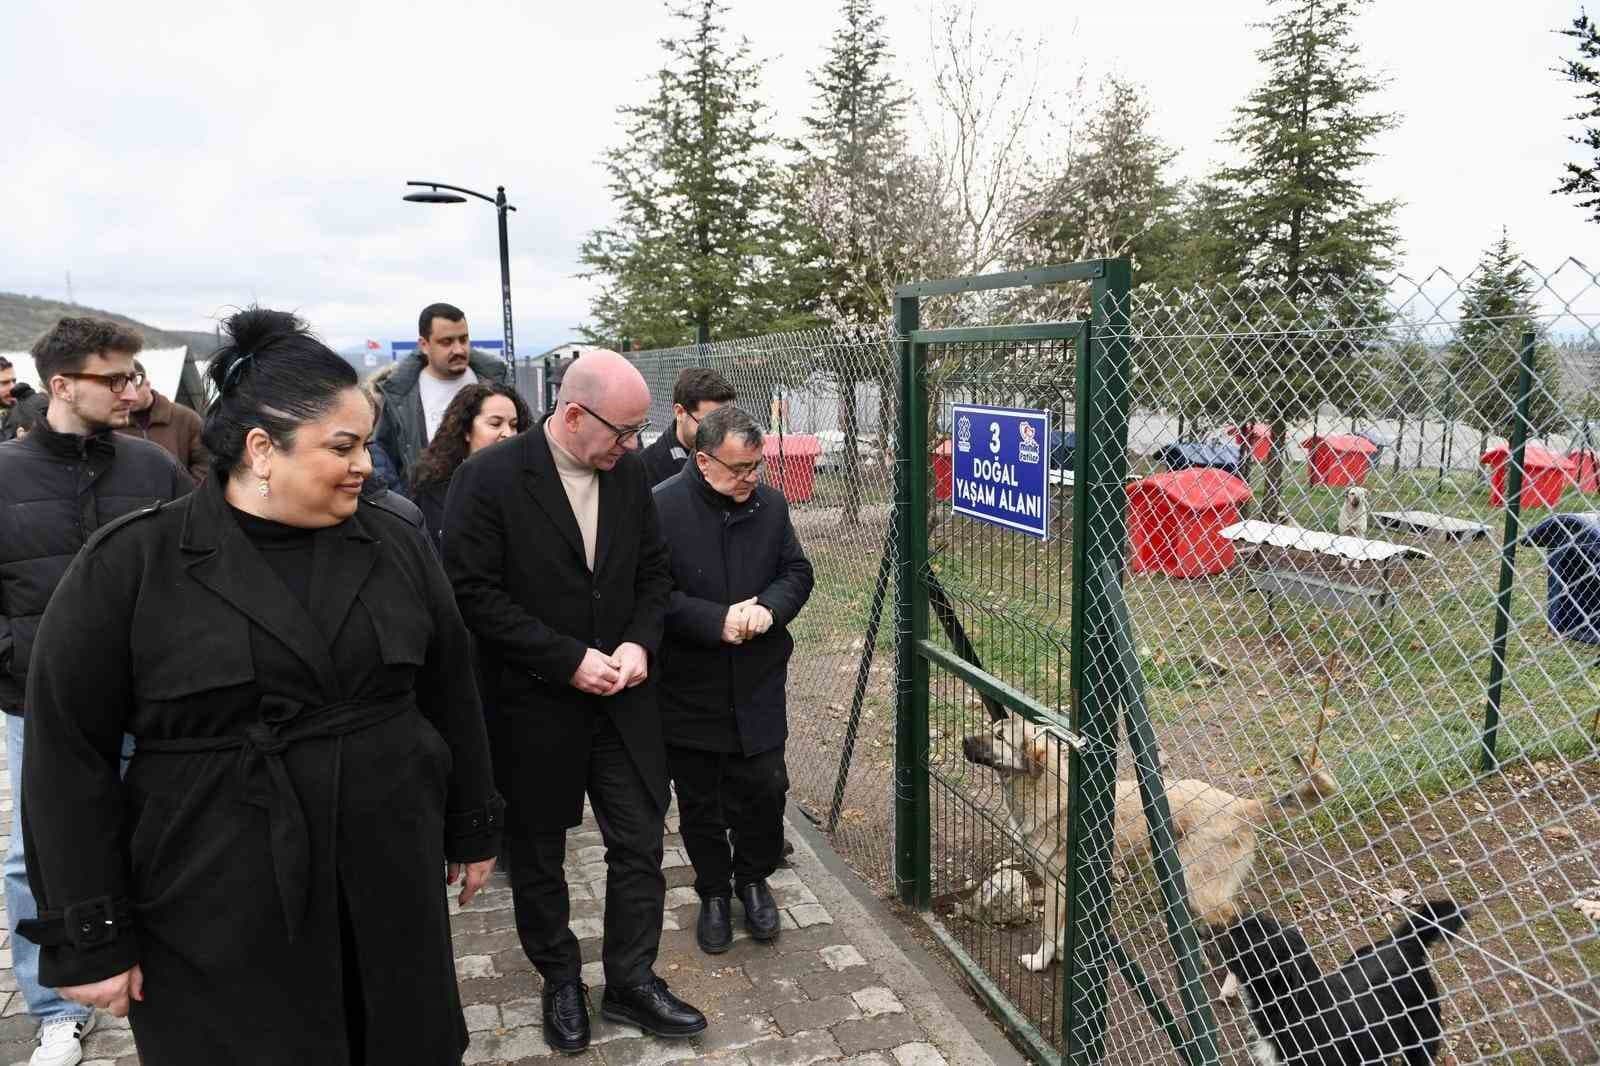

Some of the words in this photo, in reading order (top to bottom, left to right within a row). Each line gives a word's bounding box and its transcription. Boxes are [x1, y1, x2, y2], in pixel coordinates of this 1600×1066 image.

[989, 422, 1000, 451] 3
[973, 456, 1018, 487] DOĞAL
[956, 478, 995, 507] YAŞAM
[999, 489, 1041, 518] ALANI
